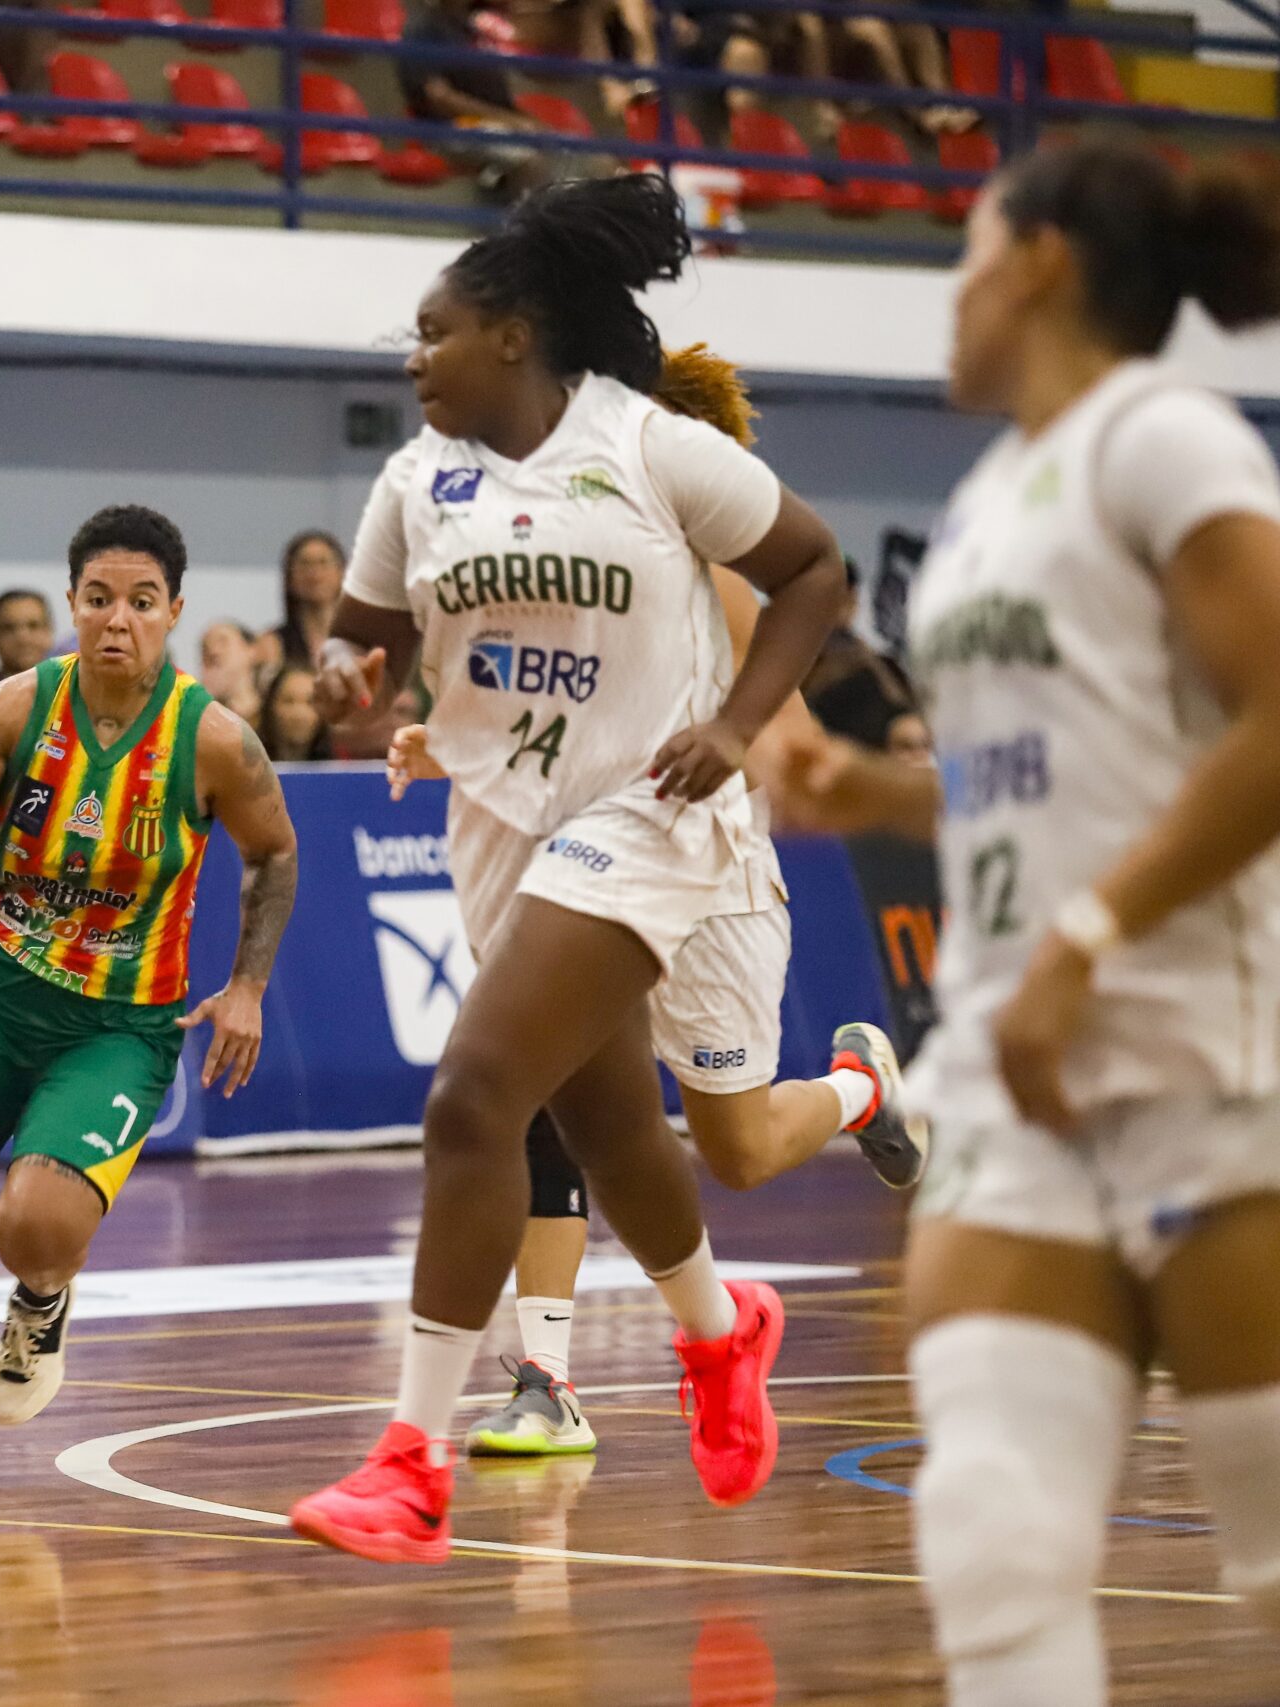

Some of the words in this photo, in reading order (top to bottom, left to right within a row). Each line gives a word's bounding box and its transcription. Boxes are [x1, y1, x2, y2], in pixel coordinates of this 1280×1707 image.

[434, 552, 634, 615] CERRADO
[517, 645, 601, 704] BRB
[506, 708, 568, 779] 14
[562, 839, 613, 874] BRB
[712, 1047, 746, 1070] BRB
[112, 1093, 138, 1147] 7
